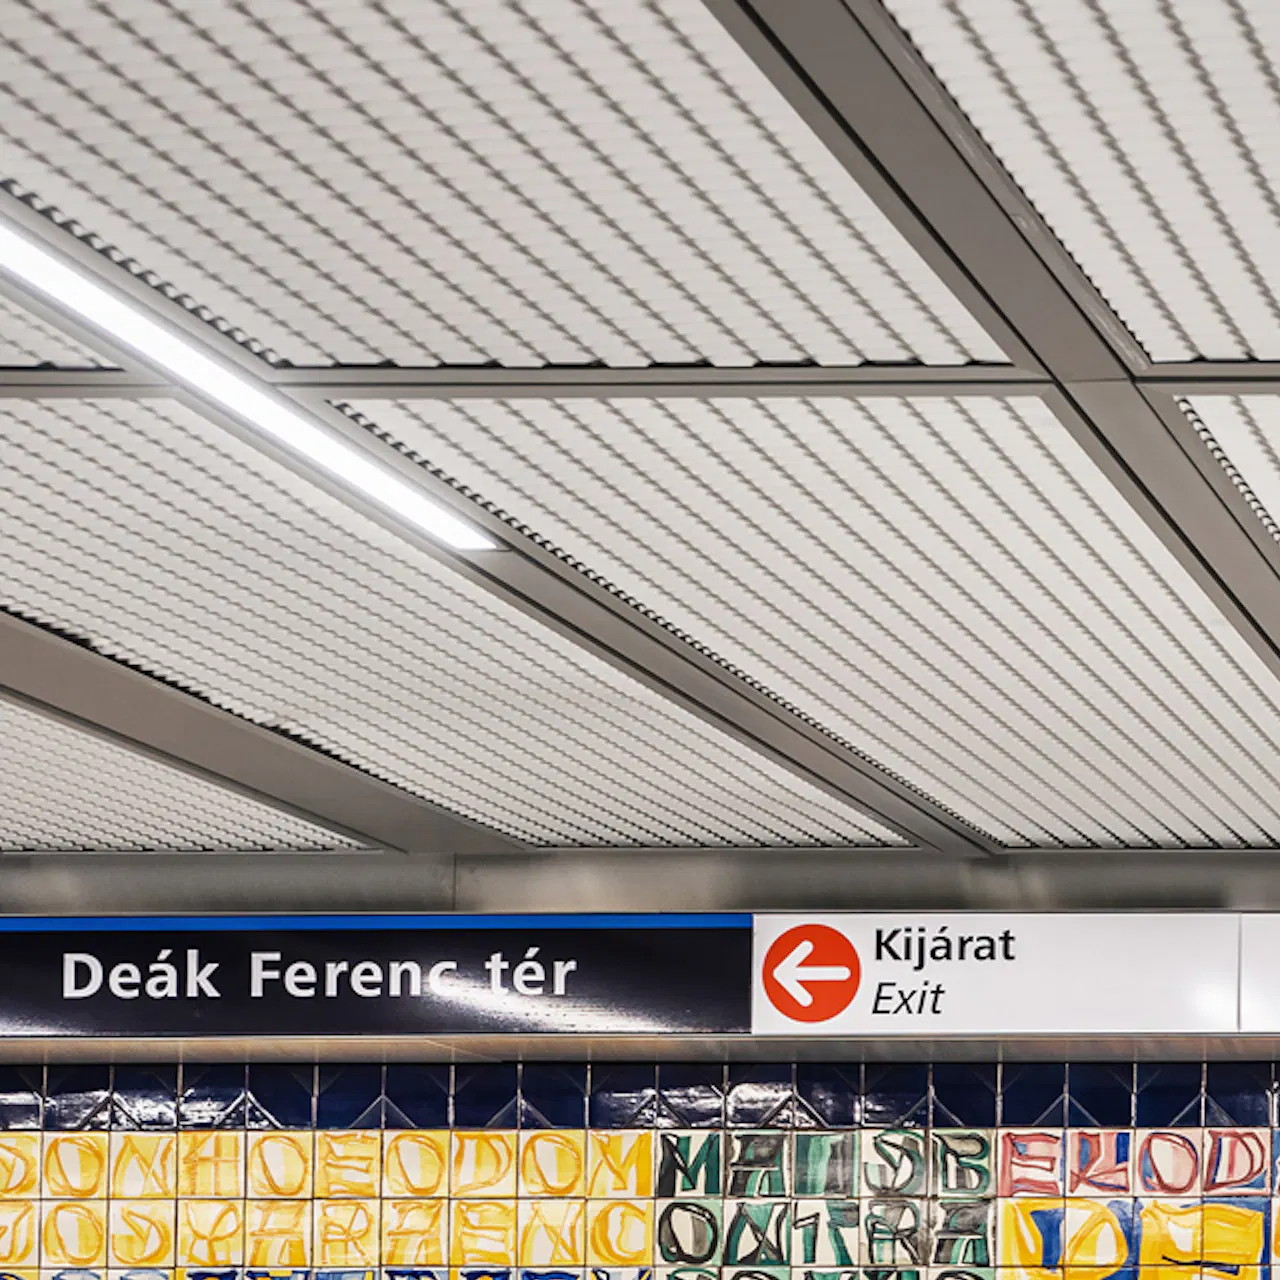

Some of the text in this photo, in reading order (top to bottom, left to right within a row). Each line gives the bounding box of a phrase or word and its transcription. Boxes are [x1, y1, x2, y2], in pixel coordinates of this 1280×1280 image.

[874, 926, 1015, 964] Kijárat
[62, 946, 578, 999] Deák Ferenc tér
[872, 980, 946, 1015] Exit
